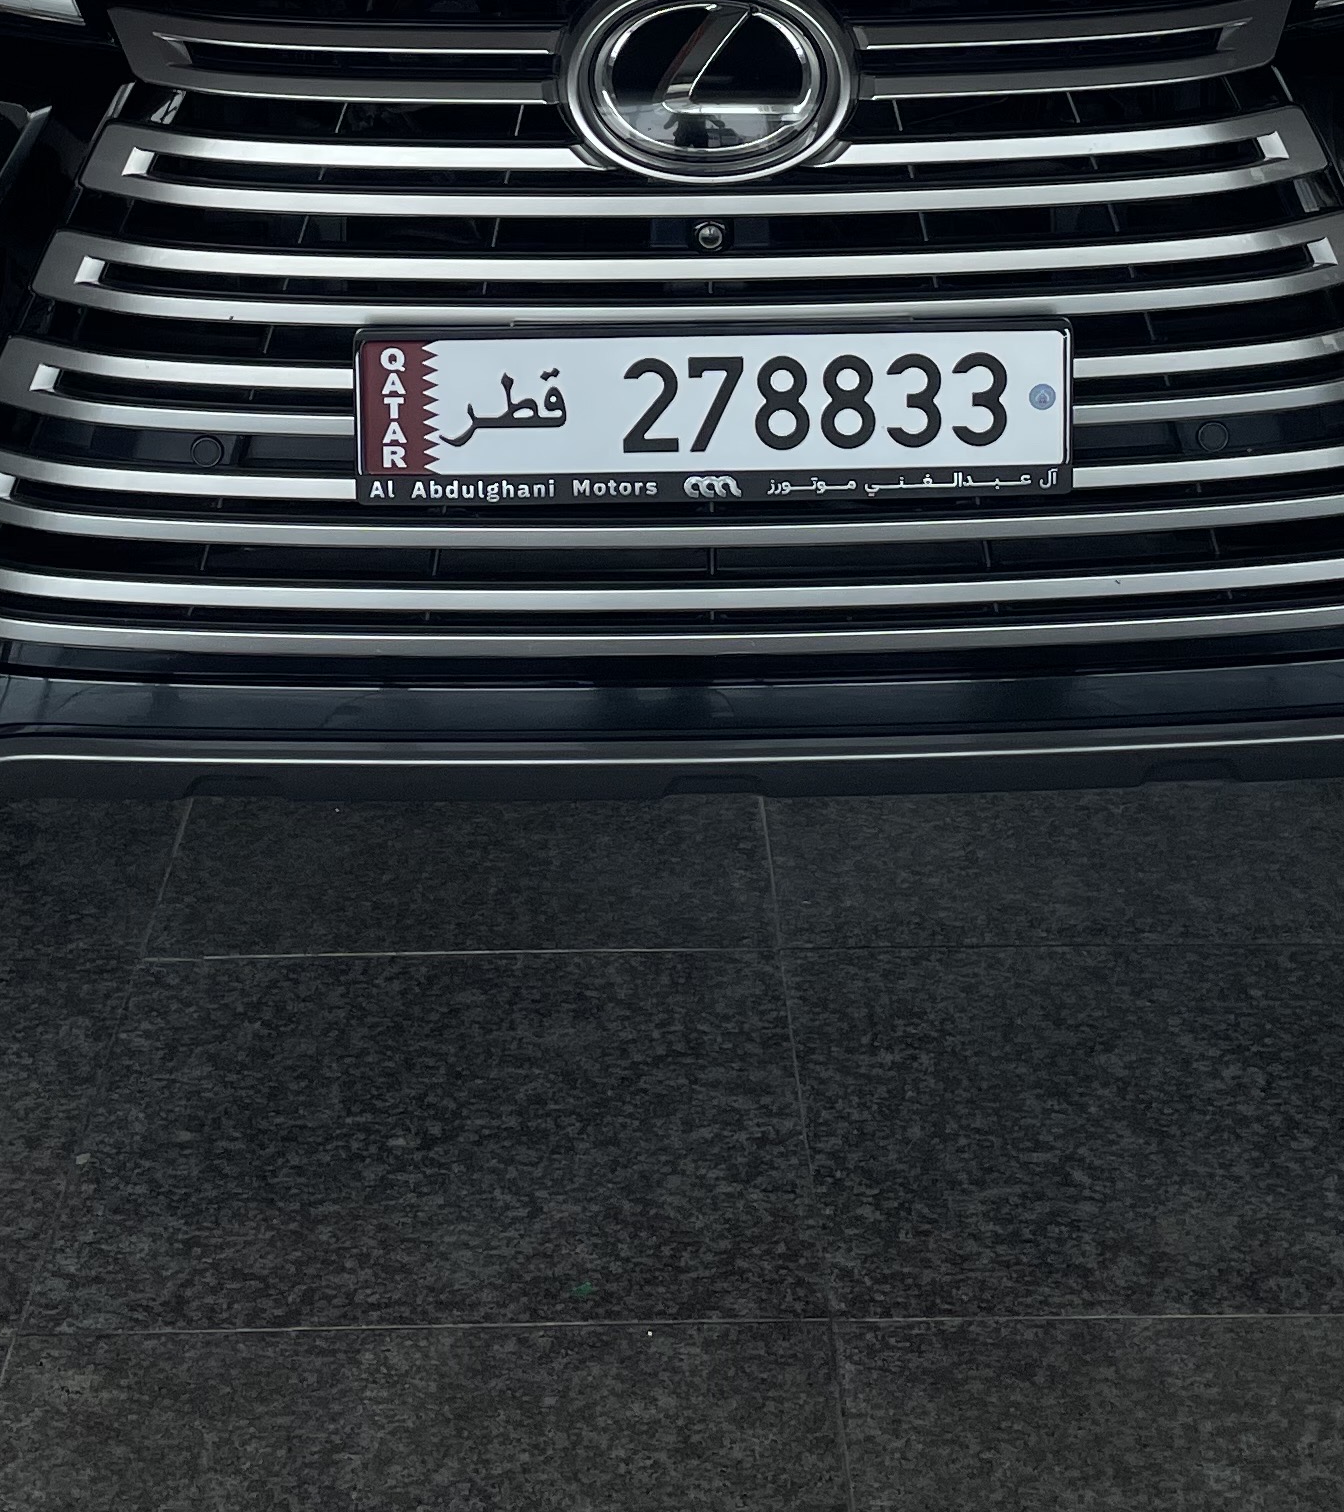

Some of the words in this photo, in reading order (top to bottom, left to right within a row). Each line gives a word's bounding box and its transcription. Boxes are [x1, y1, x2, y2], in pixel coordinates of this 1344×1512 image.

[379, 346, 408, 469] QATAR
[438, 367, 568, 448] قطر
[622, 351, 1009, 454] 278833
[369, 480, 395, 498] Al
[411, 478, 555, 503] Abdulghani
[572, 478, 658, 497] Motors
